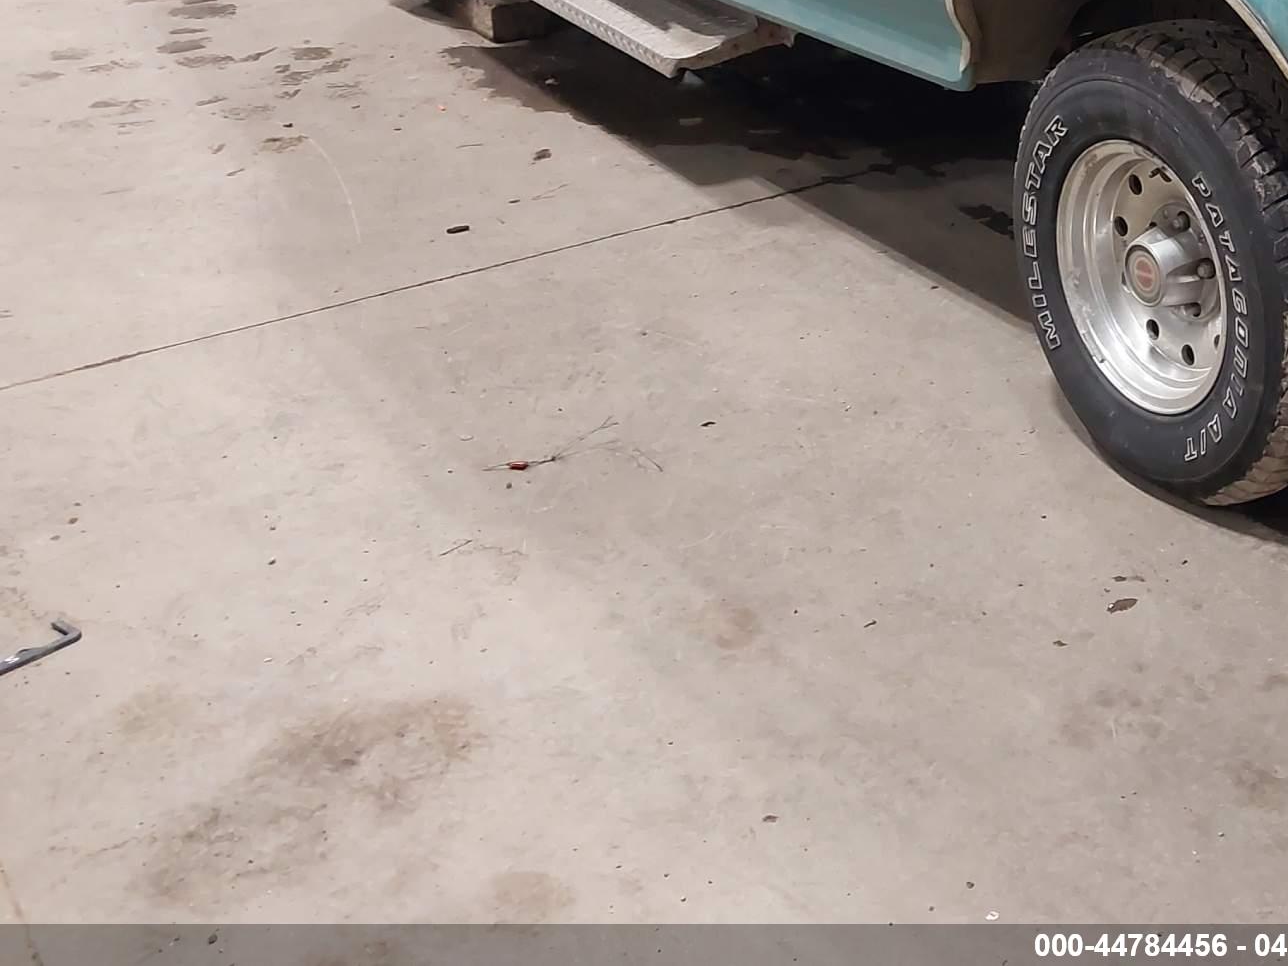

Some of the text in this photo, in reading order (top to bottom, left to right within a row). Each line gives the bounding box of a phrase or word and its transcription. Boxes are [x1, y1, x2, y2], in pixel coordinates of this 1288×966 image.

[1022, 114, 1069, 350] MILESTAR
[1184, 172, 1249, 462] PATAGONIA A/T
